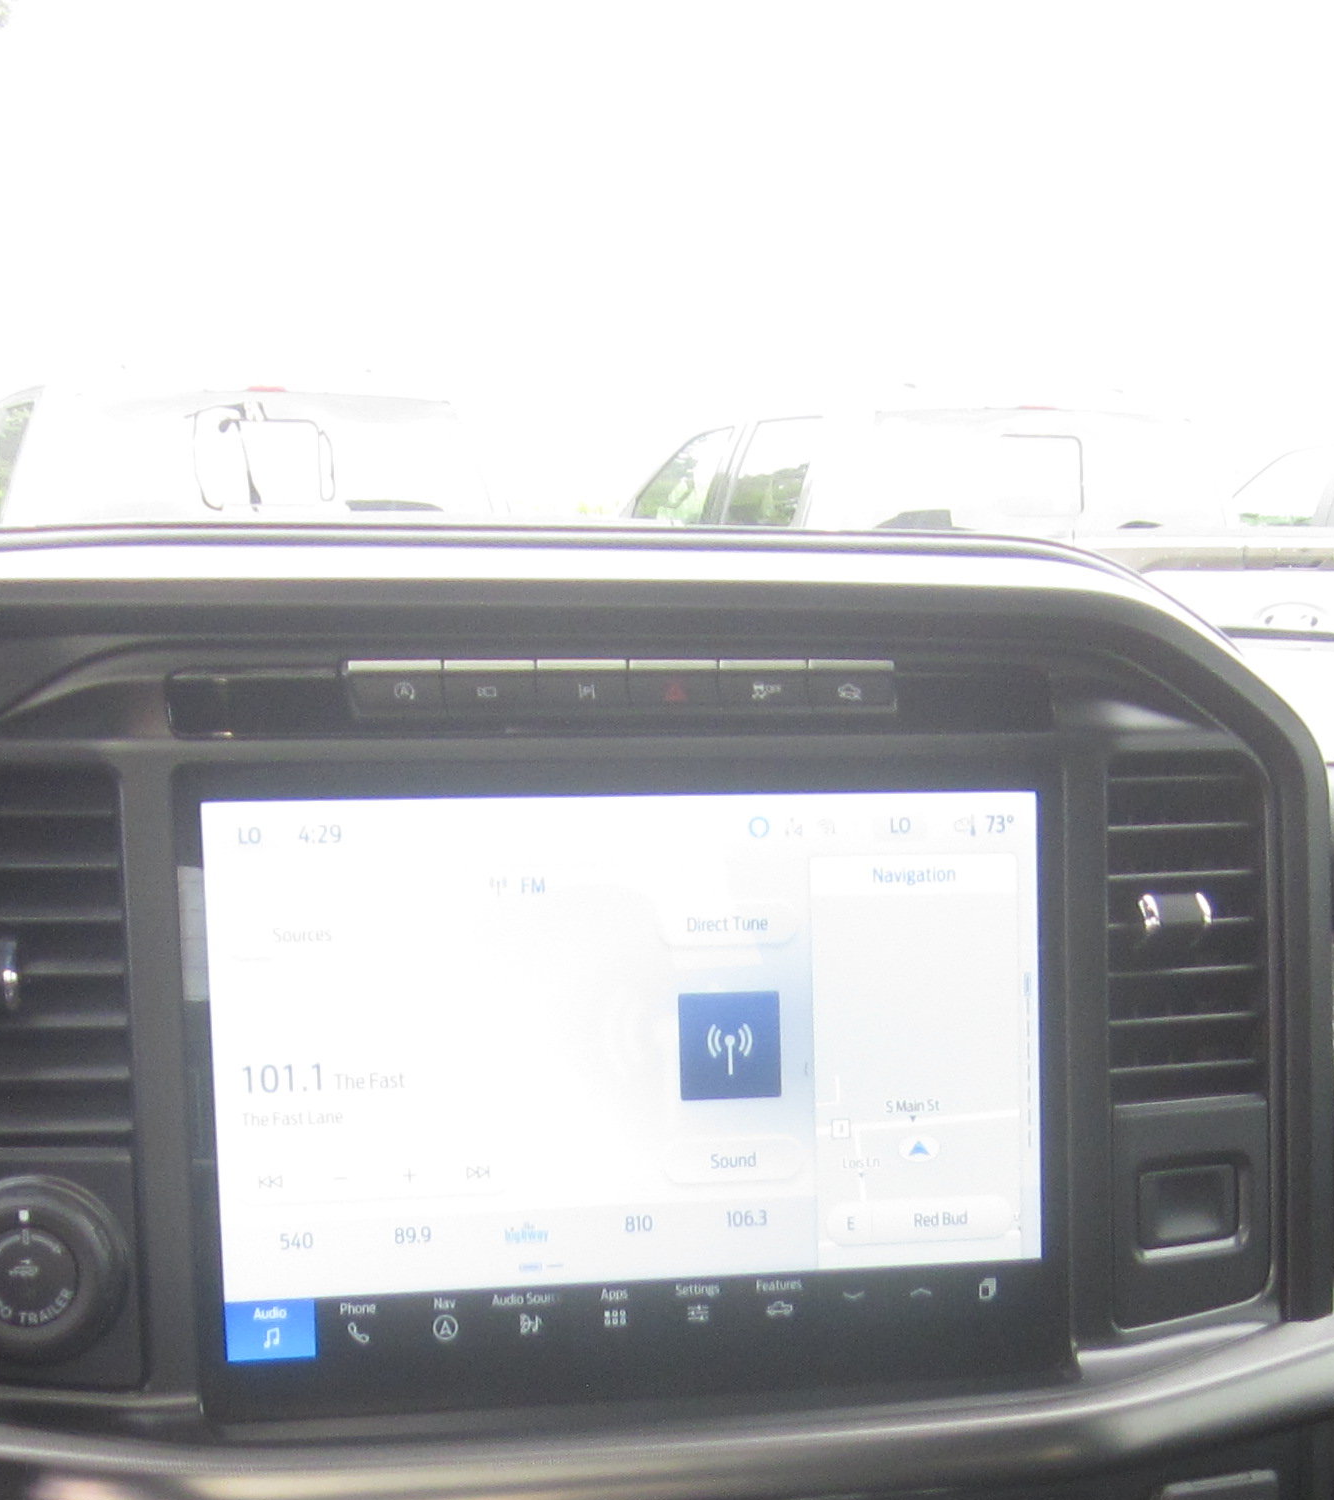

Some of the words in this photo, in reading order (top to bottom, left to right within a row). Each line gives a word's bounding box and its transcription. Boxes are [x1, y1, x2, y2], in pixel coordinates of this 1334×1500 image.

[298, 824, 343, 844] 4:29
[890, 817, 911, 834] LO
[237, 826, 262, 844] LO
[872, 867, 956, 886] Navigation
[520, 877, 546, 894] FM
[686, 917, 729, 933] Direct
[734, 916, 769, 932] Tune
[273, 927, 332, 943] Sources
[241, 1063, 323, 1094] 101.1
[333, 1073, 366, 1090] The
[370, 1072, 406, 1090] Fast
[885, 1101, 894, 1113] S
[896, 1100, 925, 1113] Main
[927, 1099, 940, 1112] St
[242, 1112, 269, 1127] The
[272, 1110, 304, 1126] Fast
[308, 1109, 344, 1125] Lane
[710, 1152, 757, 1169] Sound
[625, 1215, 653, 1232] 810
[726, 1209, 768, 1228] 106.3
[847, 1217, 855, 1231] E
[914, 1213, 940, 1228] Red
[942, 1212, 969, 1227] Bud
[279, 1232, 314, 1250] 540
[394, 1226, 432, 1244] 89.9
[675, 1282, 721, 1298] Settings
[755, 1277, 804, 1292] Features
[433, 1298, 456, 1310] Nav
[491, 1293, 524, 1307] Audio
[600, 1288, 629, 1303] Apps
[19, 1288, 74, 1325] TRAILER
[253, 1306, 288, 1321] Audio
[339, 1303, 376, 1316] Phone
